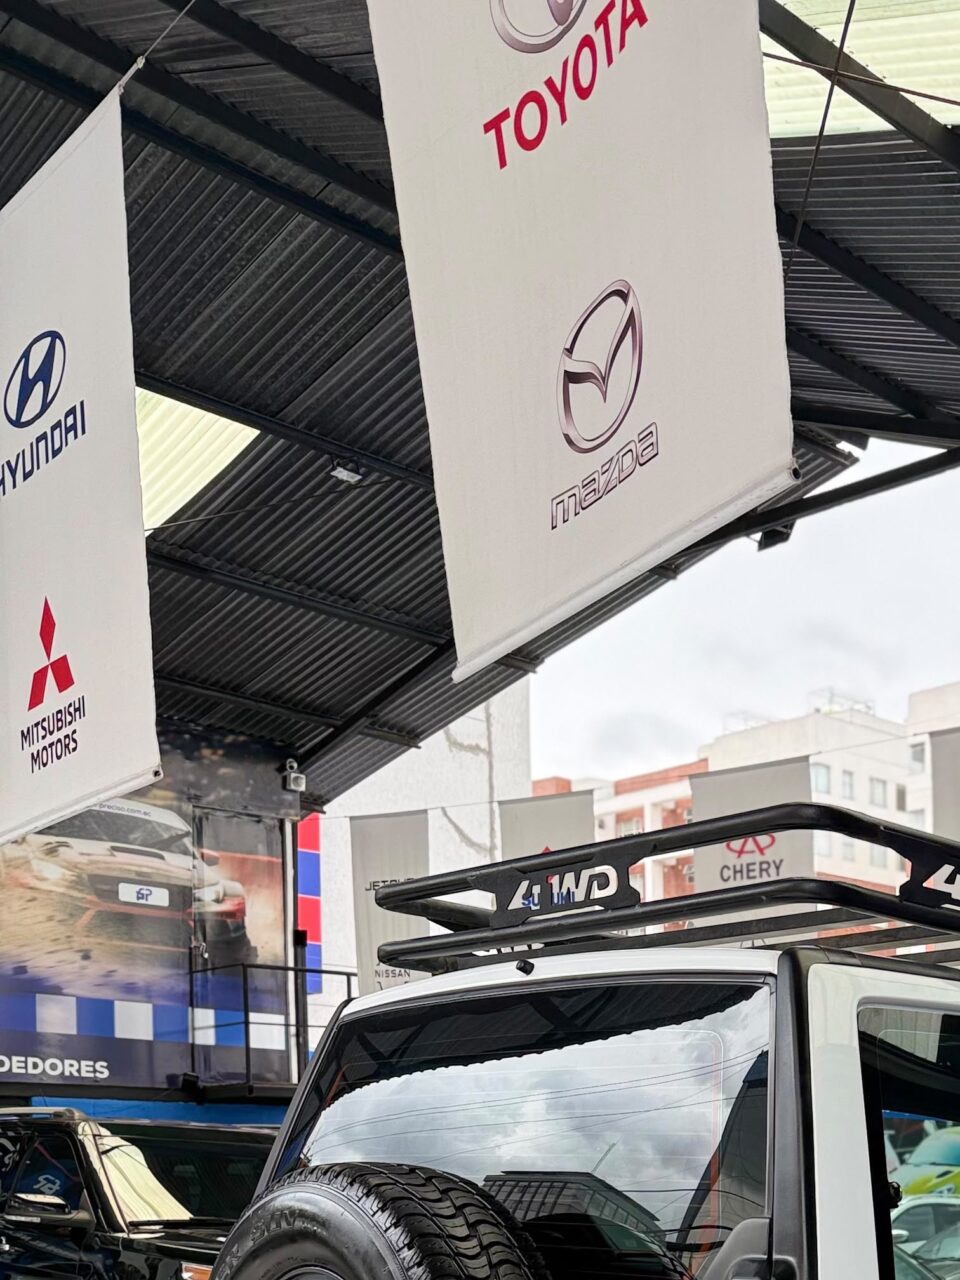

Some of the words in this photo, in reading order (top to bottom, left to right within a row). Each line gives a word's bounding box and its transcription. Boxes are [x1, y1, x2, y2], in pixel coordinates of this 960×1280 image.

[483, 0, 649, 170] TOYOTA
[20, 695, 86, 751] MITSUBISHI
[31, 728, 78, 774] MOTORS
[507, 864, 619, 911] 4WD
[719, 858, 785, 884] CHERY
[374, 968, 411, 978] NISSAN
